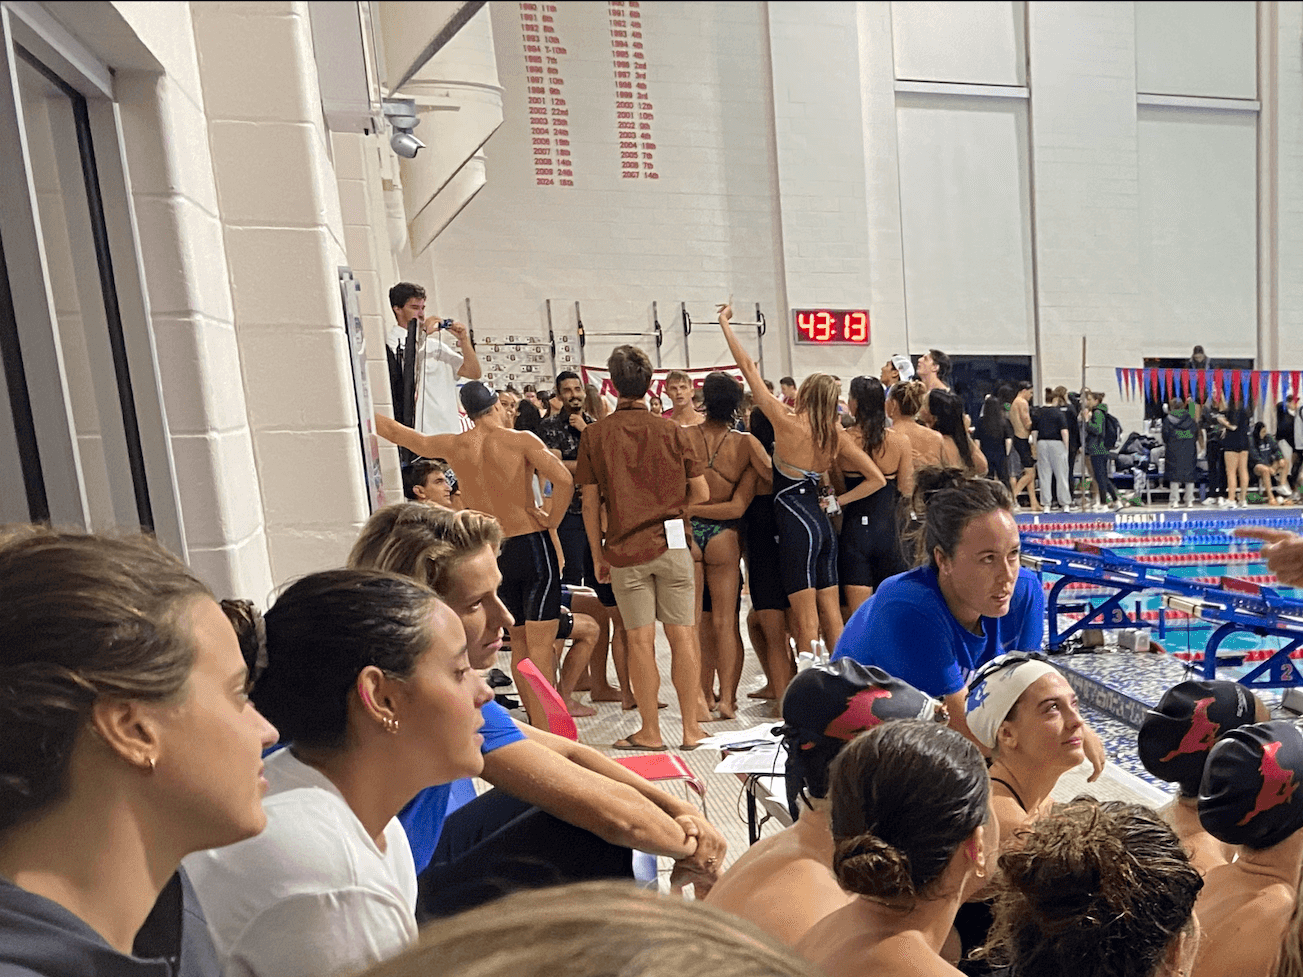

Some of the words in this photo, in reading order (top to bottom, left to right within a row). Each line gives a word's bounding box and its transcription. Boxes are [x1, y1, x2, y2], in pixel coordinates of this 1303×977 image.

[798, 312, 867, 341] 43:13
[1111, 608, 1123, 623] 3
[1281, 663, 1293, 681] 2
